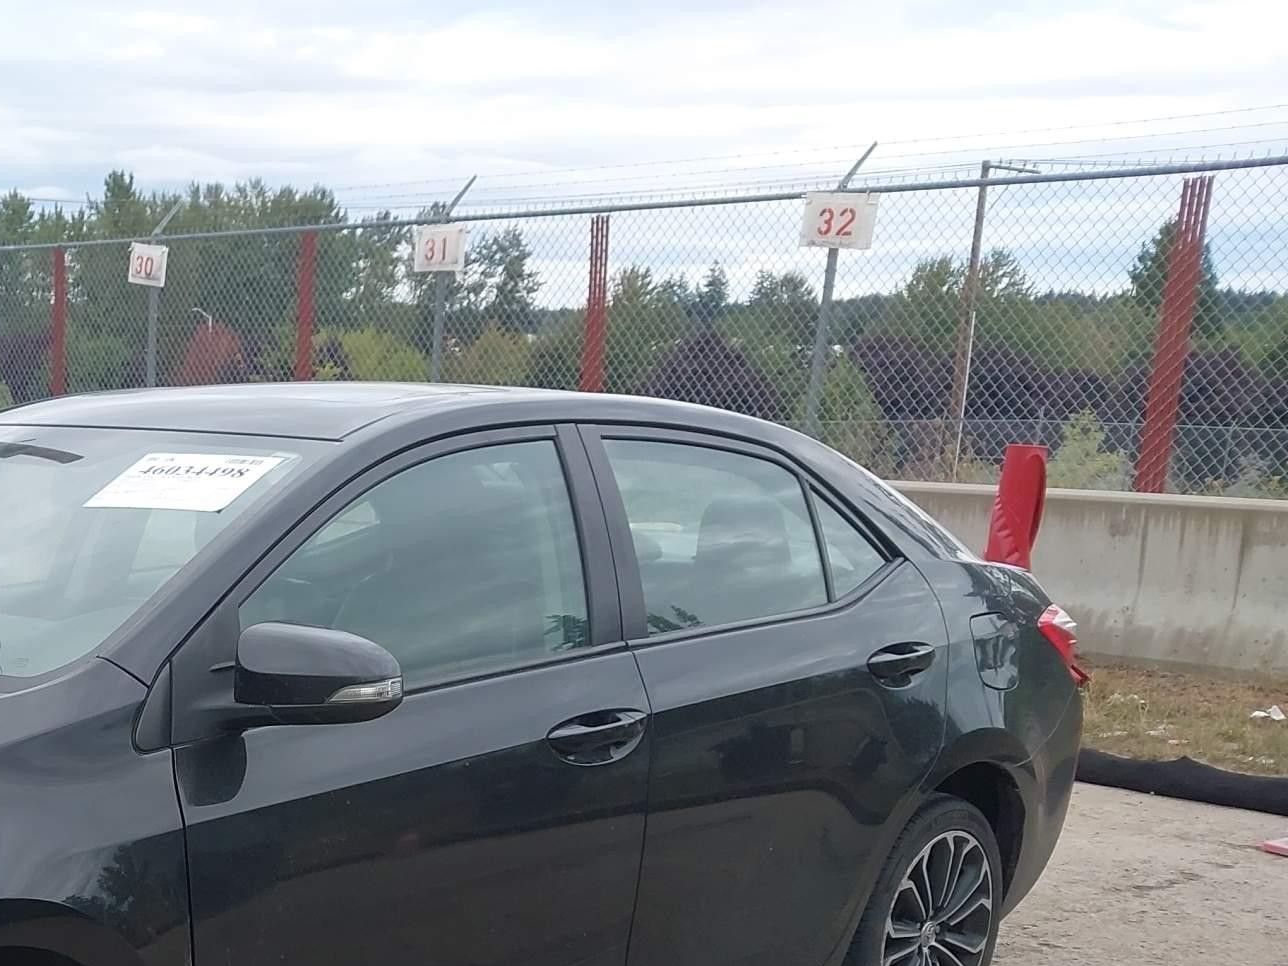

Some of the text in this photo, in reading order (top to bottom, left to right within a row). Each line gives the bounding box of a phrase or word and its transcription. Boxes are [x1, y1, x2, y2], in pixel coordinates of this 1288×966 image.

[817, 207, 857, 237] 32
[424, 237, 447, 262] 31
[135, 255, 154, 277] 30
[139, 465, 250, 478] 46034498
